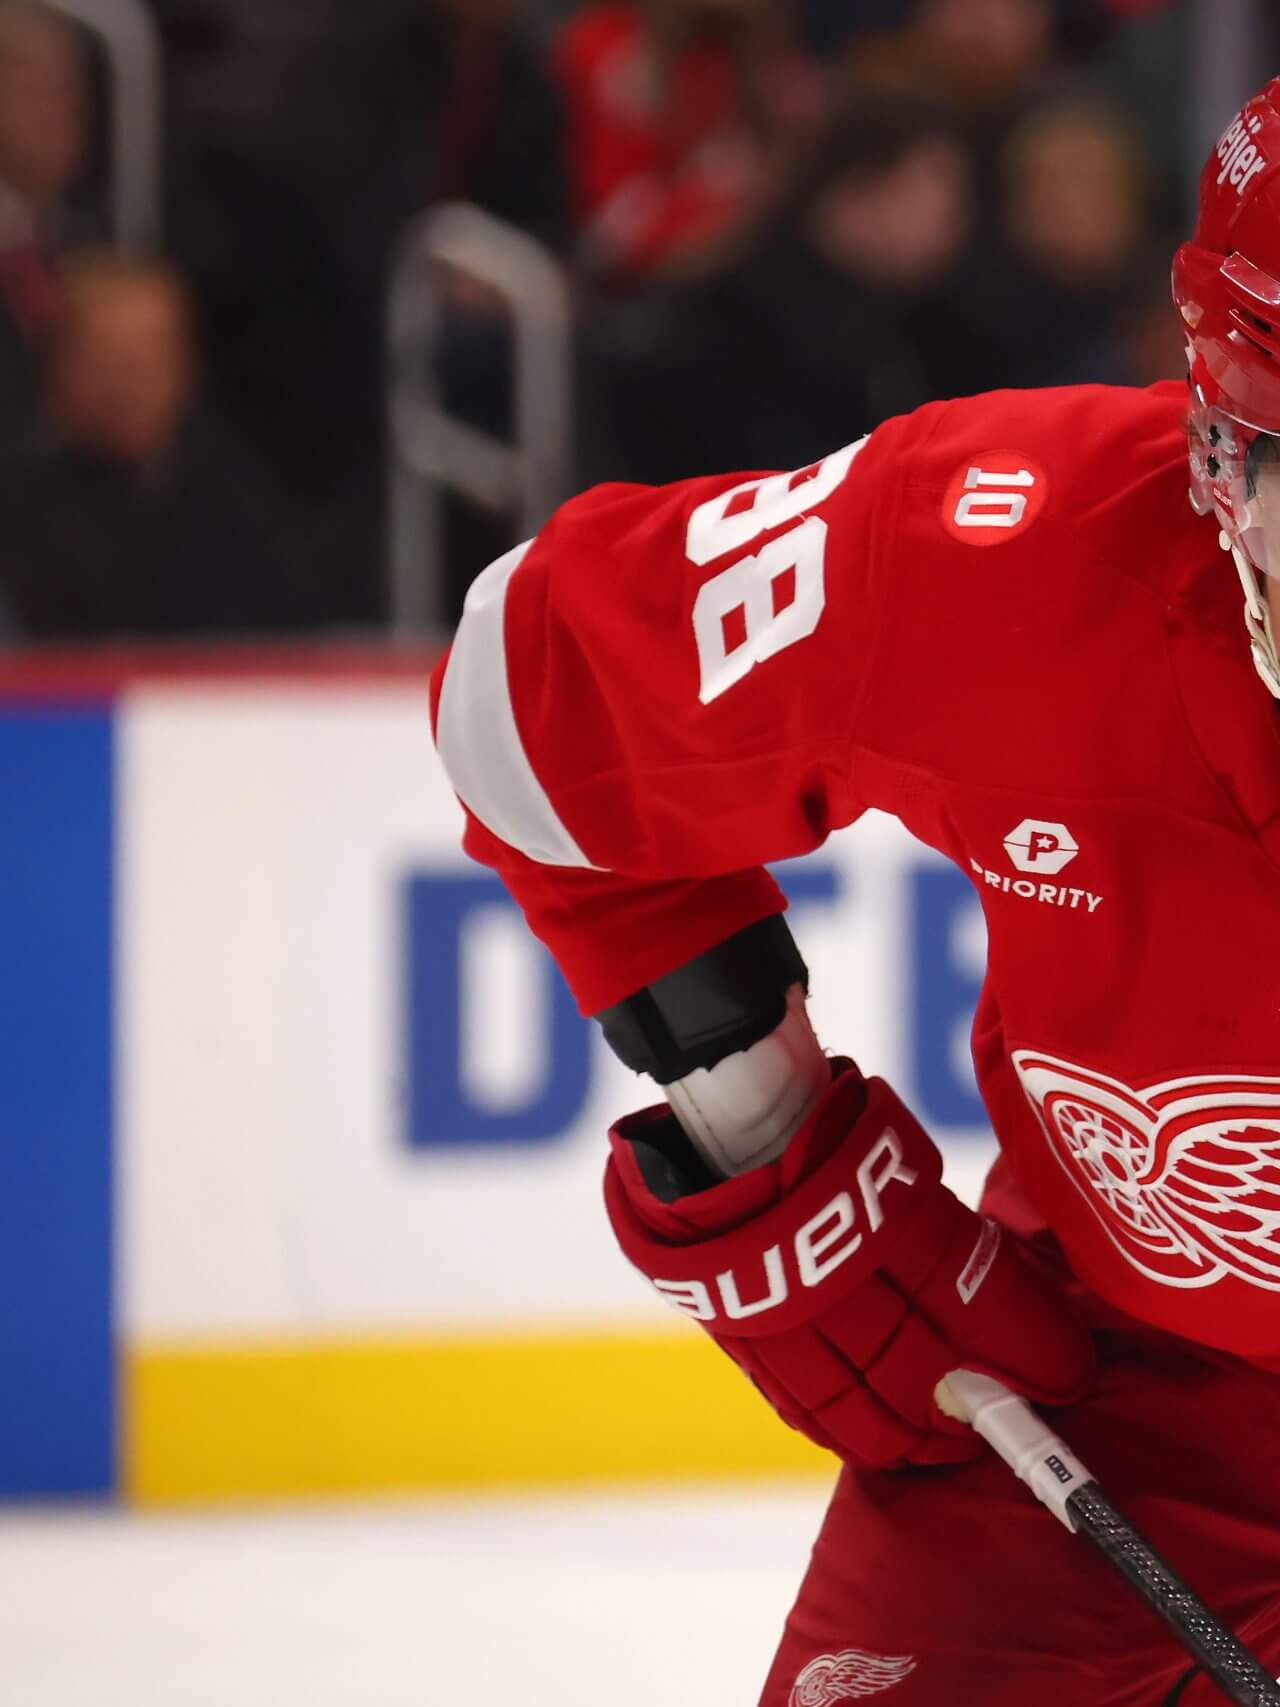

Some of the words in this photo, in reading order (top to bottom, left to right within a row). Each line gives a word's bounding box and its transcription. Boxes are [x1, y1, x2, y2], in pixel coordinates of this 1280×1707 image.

[1216, 111, 1267, 195] eijer
[686, 434, 872, 705] 88
[953, 466, 1036, 528] 10
[404, 868, 998, 1149] DE
[653, 1126, 919, 1321] AUER
